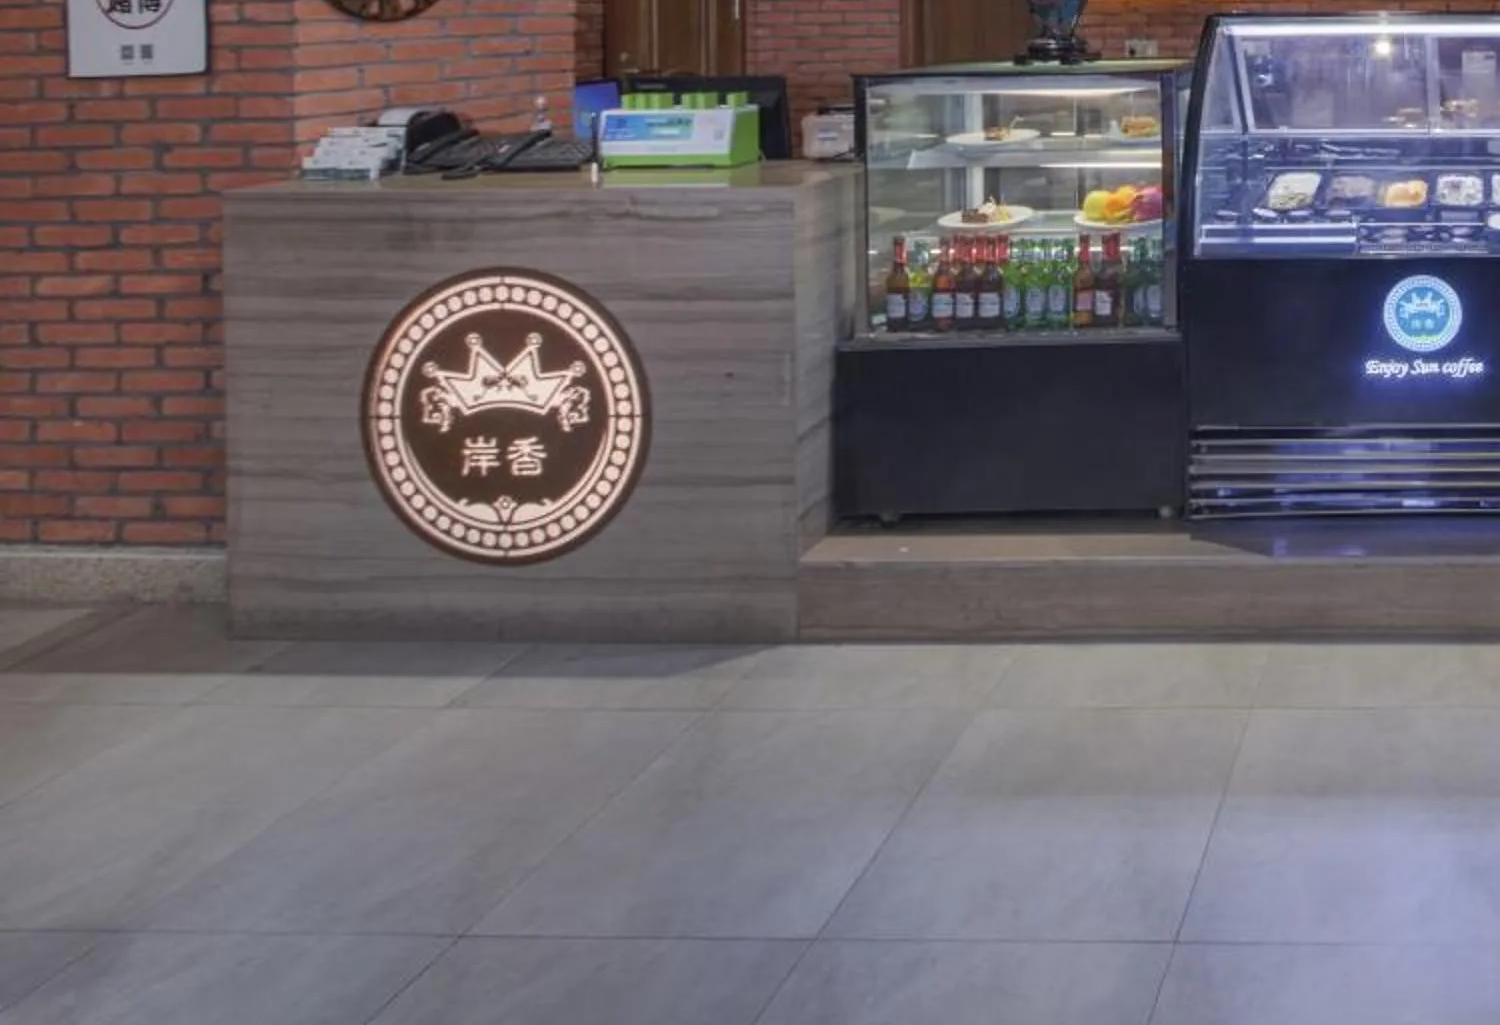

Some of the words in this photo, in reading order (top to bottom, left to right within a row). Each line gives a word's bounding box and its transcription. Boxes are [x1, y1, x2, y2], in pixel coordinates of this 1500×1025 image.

[1364, 359, 1409, 378] Enjoy
[1410, 358, 1441, 375] Sun
[1441, 357, 1484, 378] coffee
[461, 435, 548, 477] 岸香
